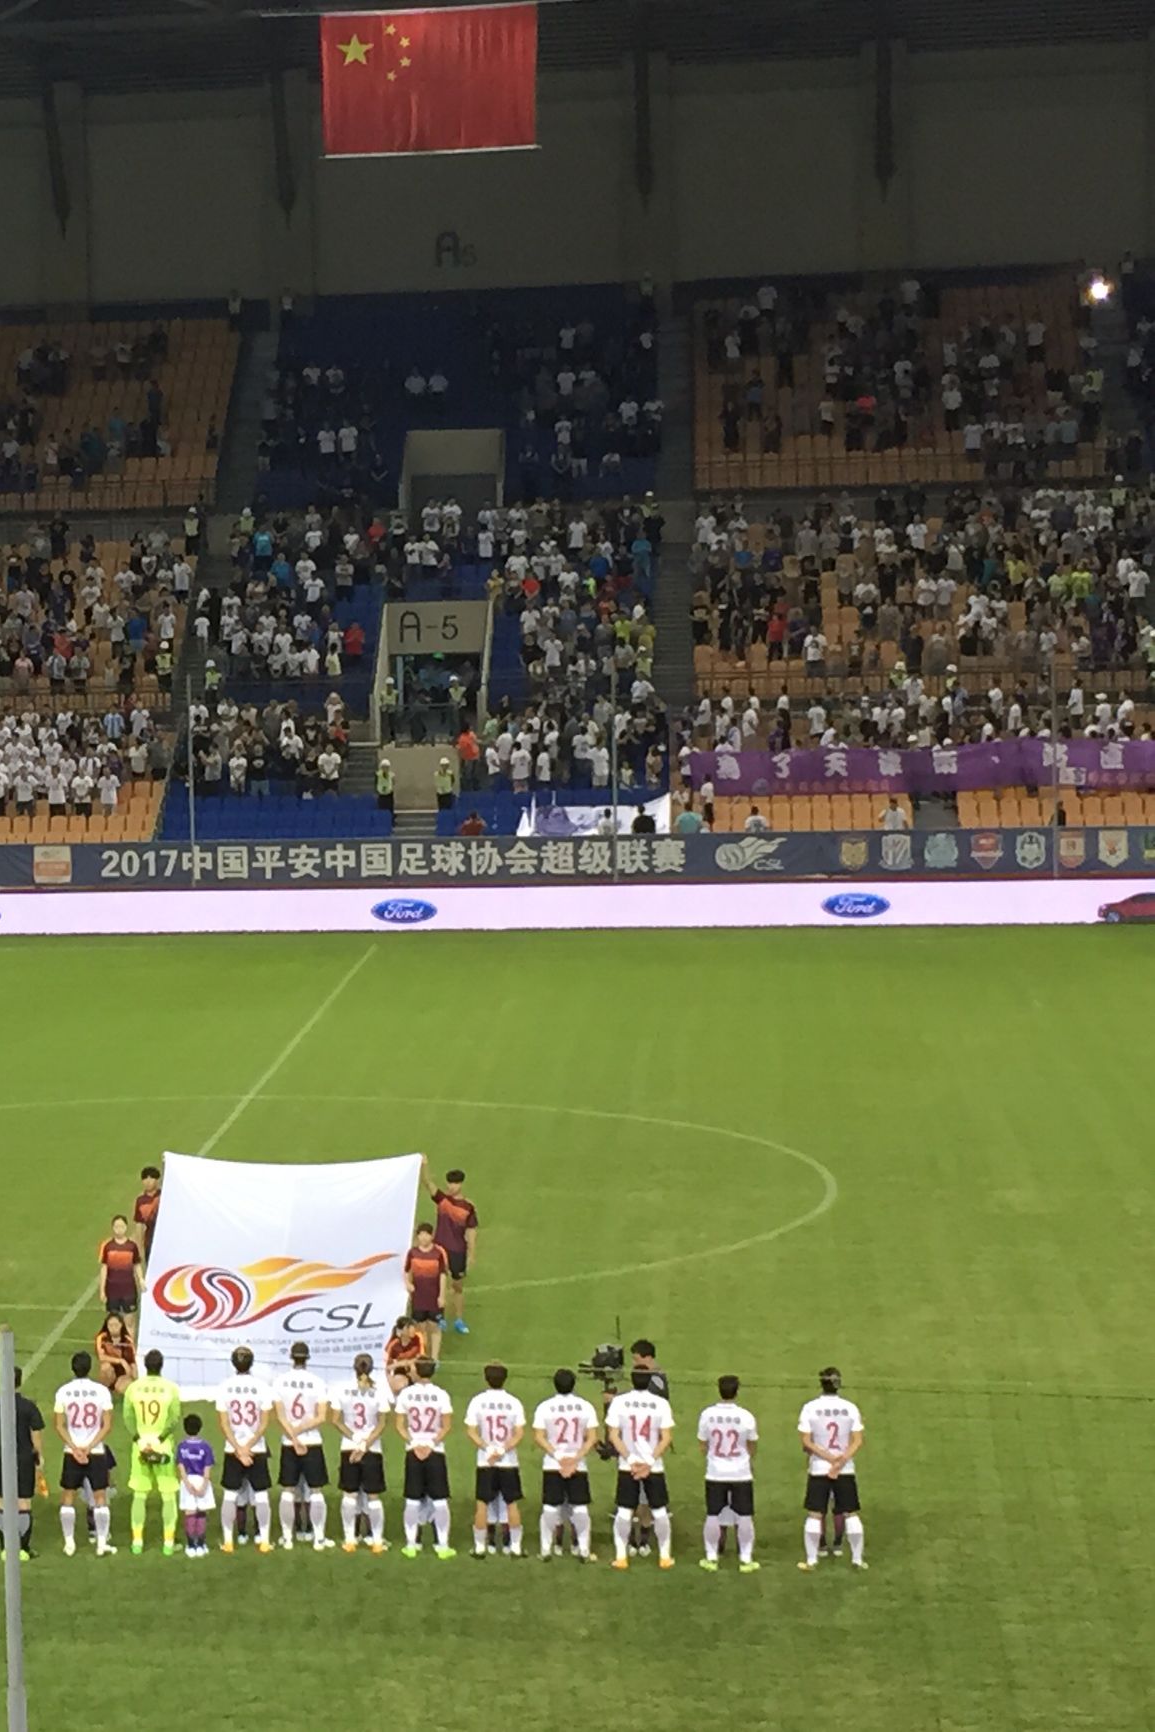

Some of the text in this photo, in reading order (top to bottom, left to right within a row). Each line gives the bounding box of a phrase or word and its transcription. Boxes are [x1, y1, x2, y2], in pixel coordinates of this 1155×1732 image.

[399, 609, 459, 644] A-5
[100, 837, 687, 881] 2017中国平安中国足球协会超级联赛
[384, 902, 424, 919] Ford
[835, 897, 877, 914] Ford
[282, 1301, 387, 1334] CSL
[67, 1401, 98, 1429] 28
[139, 1399, 161, 1426] 19
[229, 1399, 258, 1427] 33
[291, 1392, 306, 1421] 6
[352, 1402, 367, 1430] 3
[408, 1406, 438, 1433] 32
[486, 1415, 509, 1443] 15
[554, 1416, 579, 1444] 21
[628, 1415, 652, 1442] 14
[826, 1421, 841, 1450] 2
[711, 1428, 741, 1458] 22
